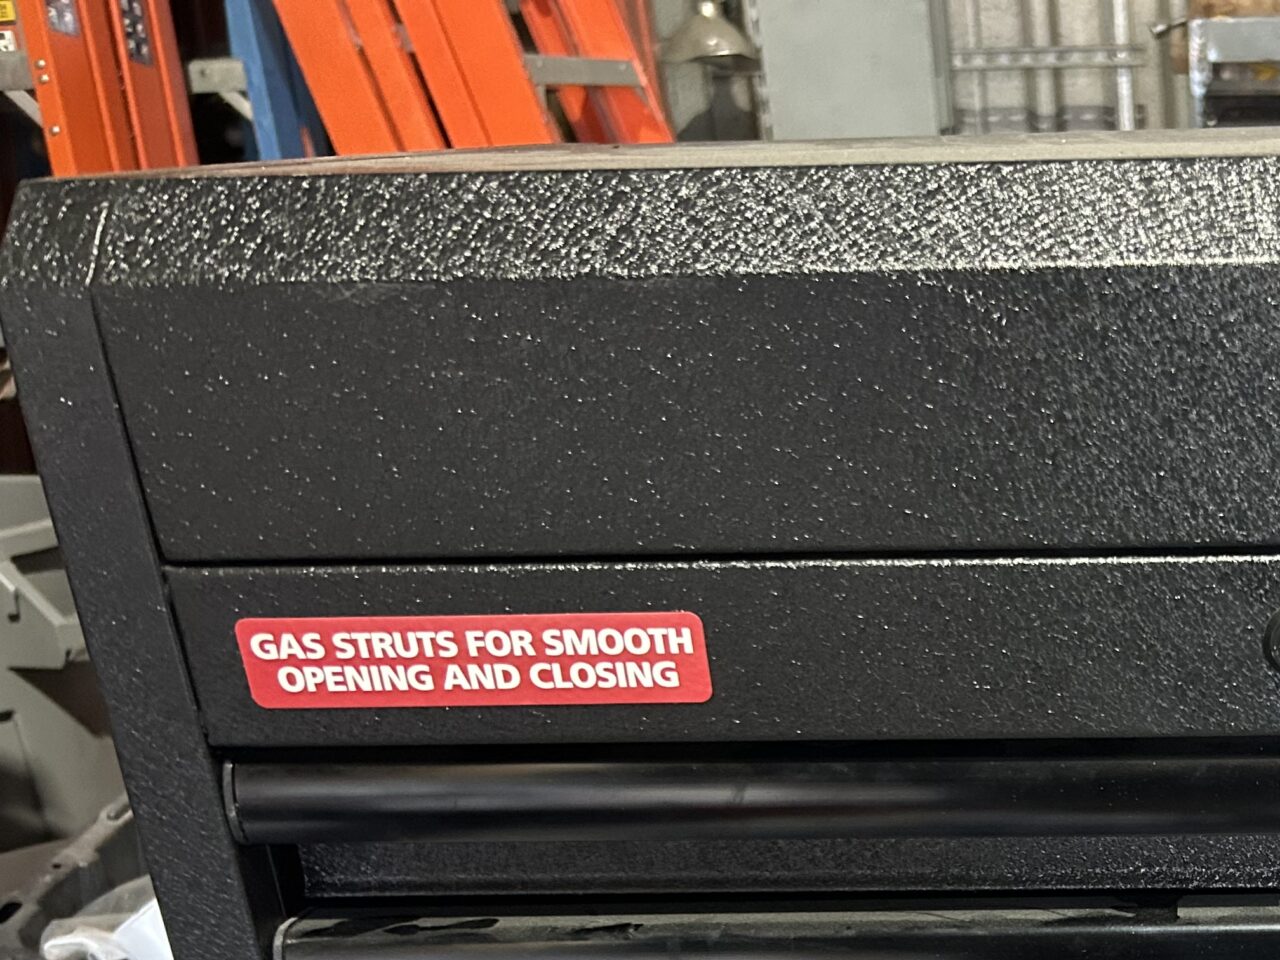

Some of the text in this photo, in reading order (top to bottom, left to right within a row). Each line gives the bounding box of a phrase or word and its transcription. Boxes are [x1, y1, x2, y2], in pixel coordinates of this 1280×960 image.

[249, 626, 694, 661] GAS STRUTS FOR SMOOTH
[276, 660, 680, 693] OPENING AND CLOSING
